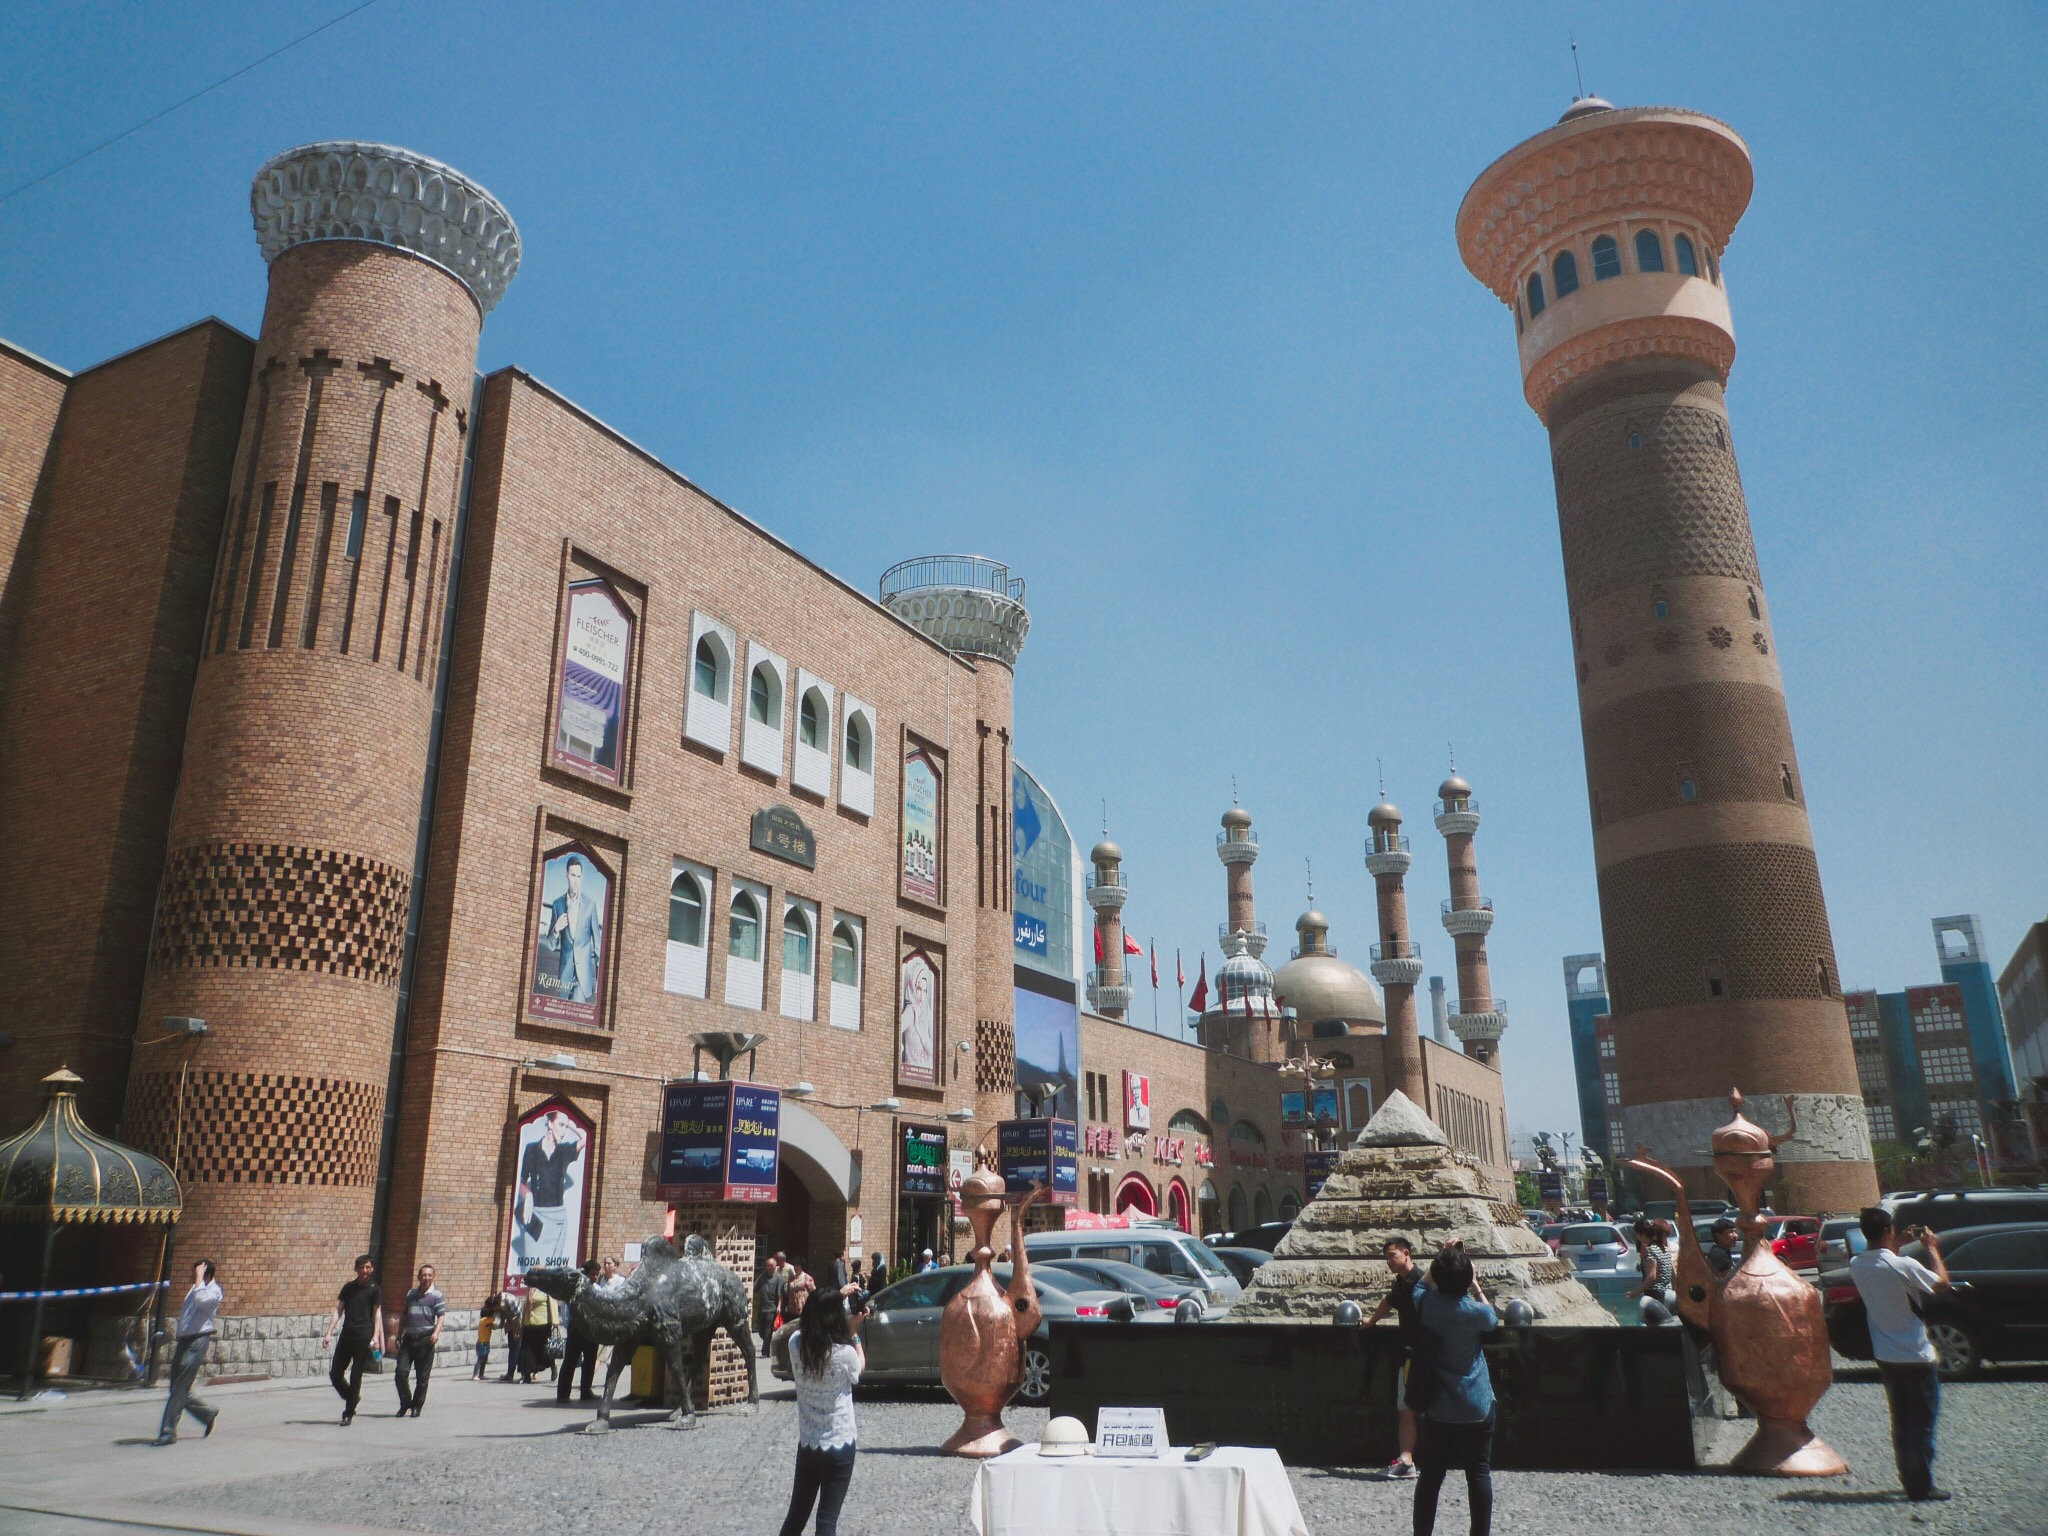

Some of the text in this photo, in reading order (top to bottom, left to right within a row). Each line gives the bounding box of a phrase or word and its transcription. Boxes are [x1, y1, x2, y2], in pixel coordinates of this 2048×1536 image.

[576, 617, 619, 647] FLEISCHER
[1153, 1136, 1185, 1162] KFC
[517, 1256, 570, 1267] MODA SHOW
[1102, 1433, 1153, 1447] 开包检查
